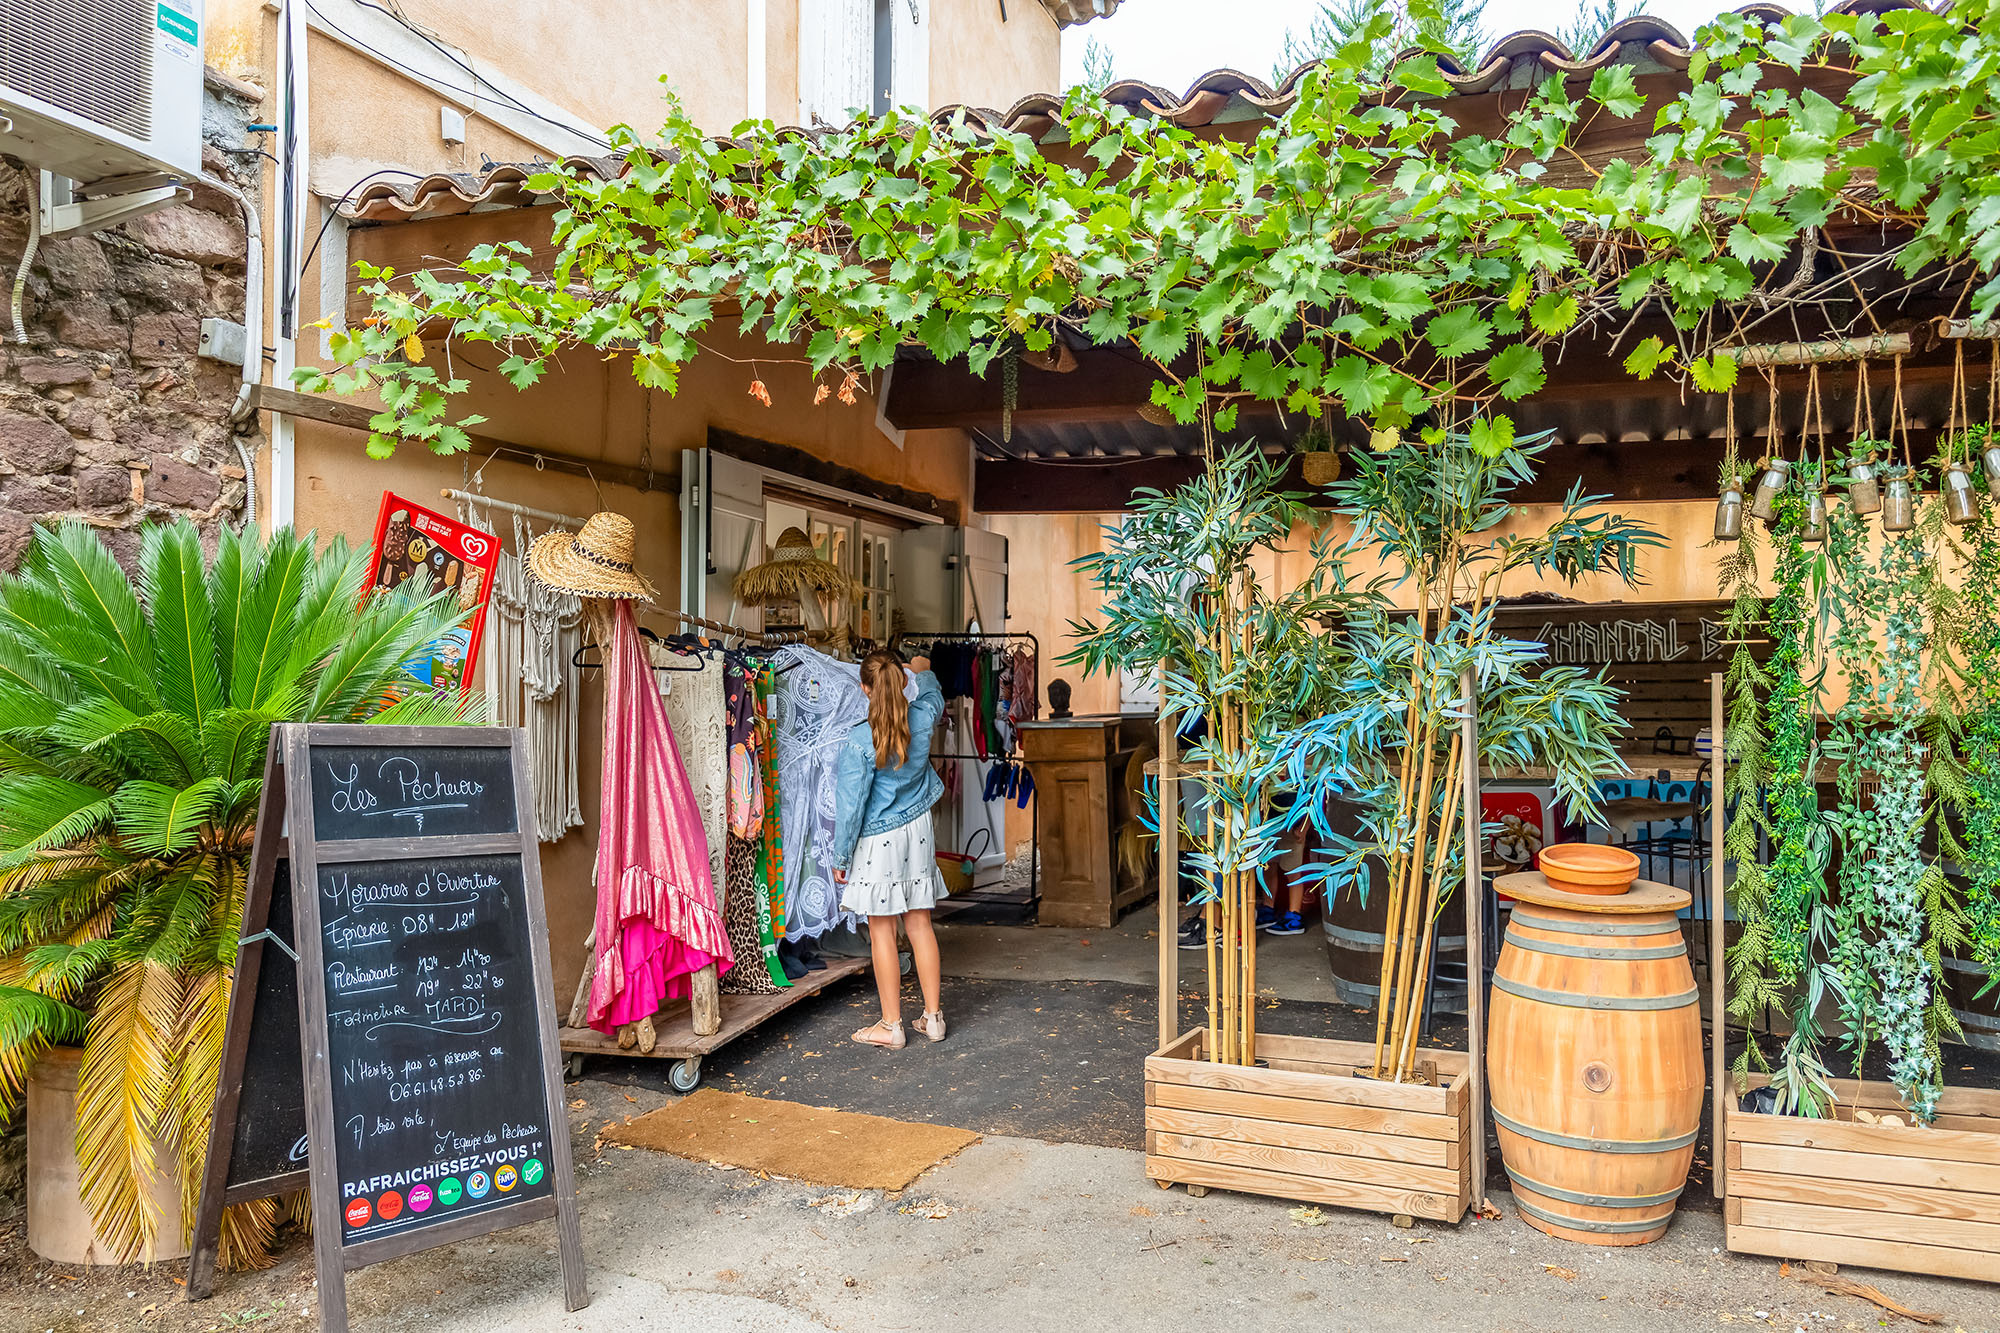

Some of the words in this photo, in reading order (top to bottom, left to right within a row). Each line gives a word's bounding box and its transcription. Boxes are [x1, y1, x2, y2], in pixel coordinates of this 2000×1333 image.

[328, 763, 378, 813] Les
[324, 872, 409, 908] Horaires
[400, 1059, 422, 1080] pas
[427, 1054, 437, 1067] à
[370, 1115, 396, 1137] très
[343, 1144, 528, 1198] RAFRAICHISSEZ-VOUS
